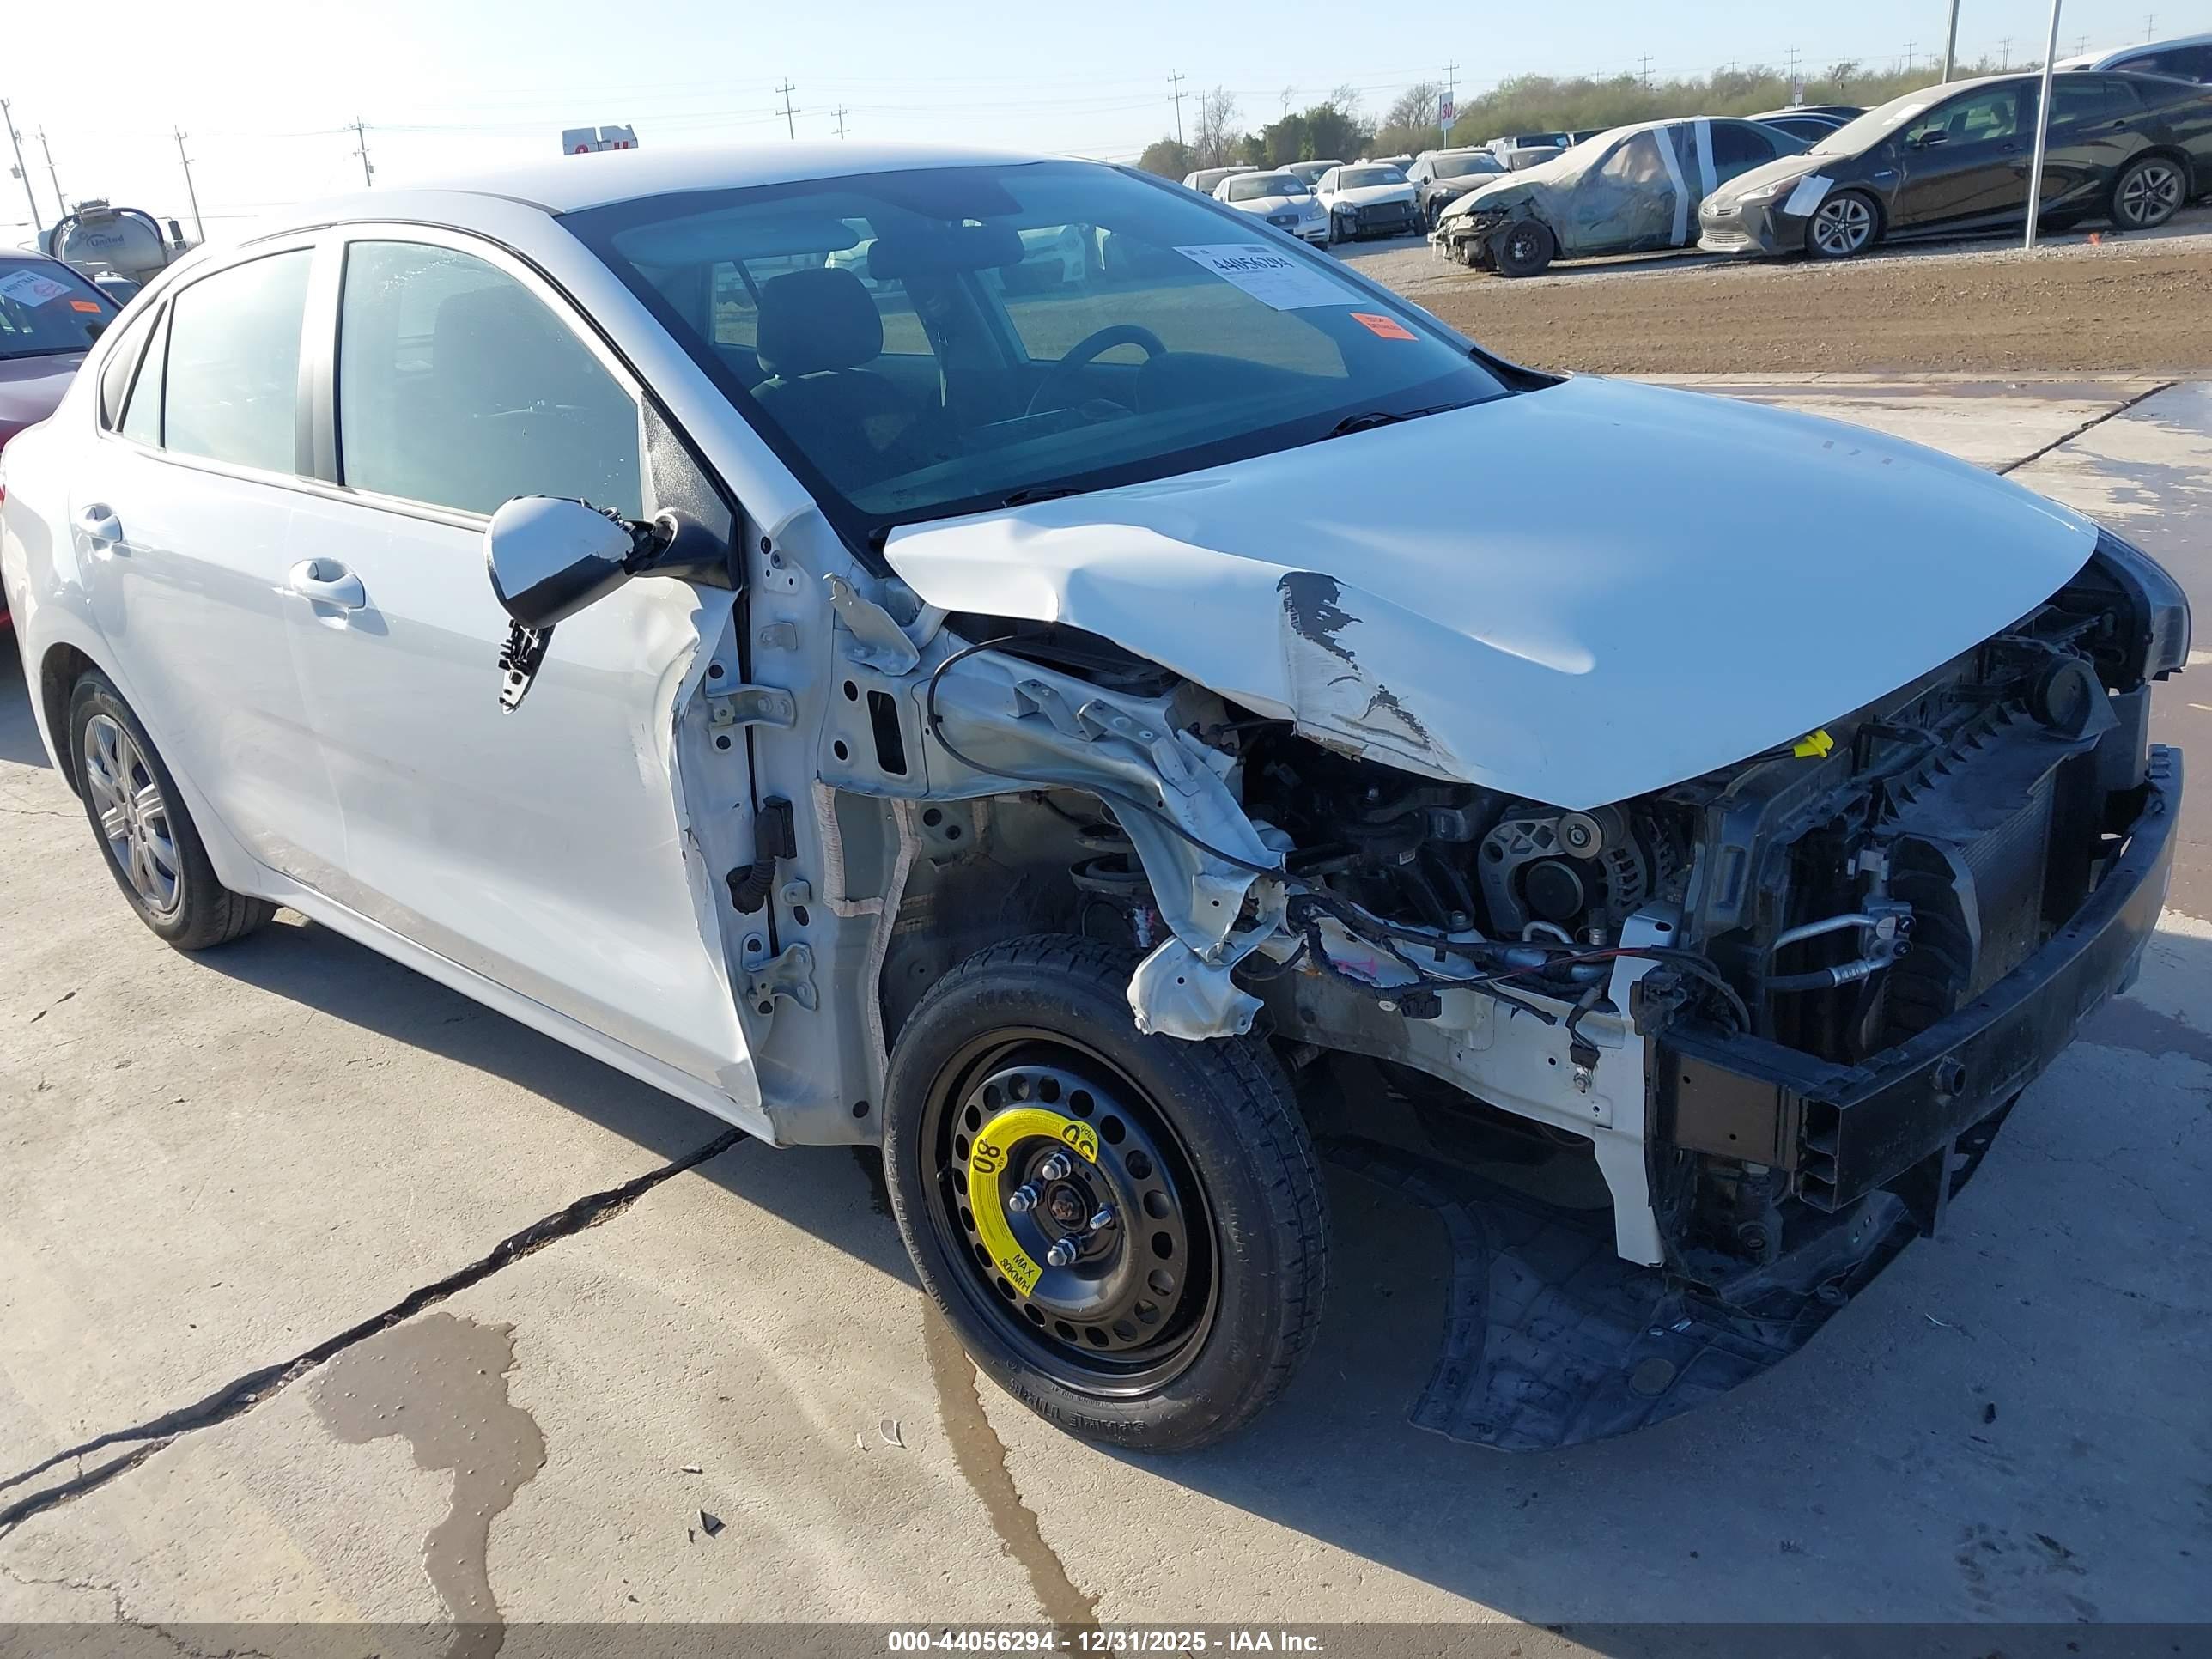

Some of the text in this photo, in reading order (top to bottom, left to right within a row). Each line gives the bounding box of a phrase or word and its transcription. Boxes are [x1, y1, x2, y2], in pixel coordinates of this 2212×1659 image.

[1442, 101, 1453, 119] 30
[1212, 257, 1295, 271] 44056294
[972, 1139, 1001, 1174] 80
[1000, 1258, 1031, 1292] 80KM/H
[1013, 1254, 1036, 1279] MAX
